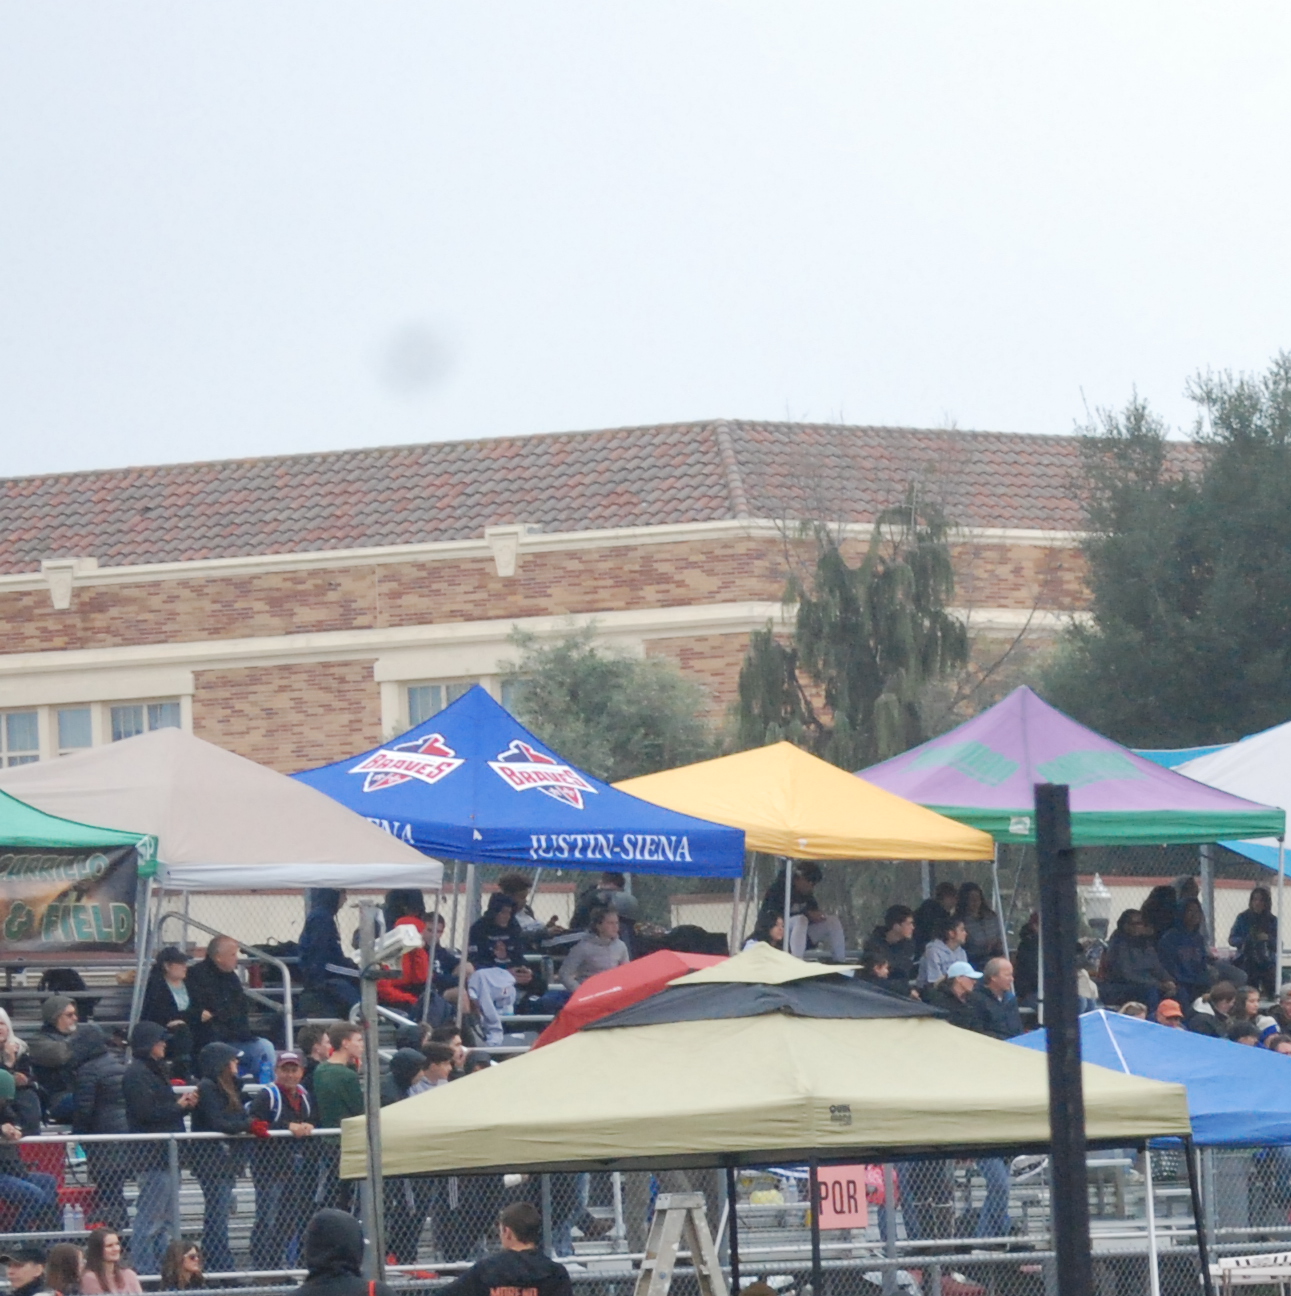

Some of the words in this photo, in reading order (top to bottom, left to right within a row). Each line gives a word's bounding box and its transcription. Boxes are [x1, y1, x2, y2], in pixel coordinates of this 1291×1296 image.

[361, 753, 455, 779] BRAVES
[499, 766, 584, 786] BRAVES
[529, 834, 692, 862] JUSTIN-SIENA
[41, 902, 133, 943] FIELD
[819, 1181, 858, 1215] PQR
